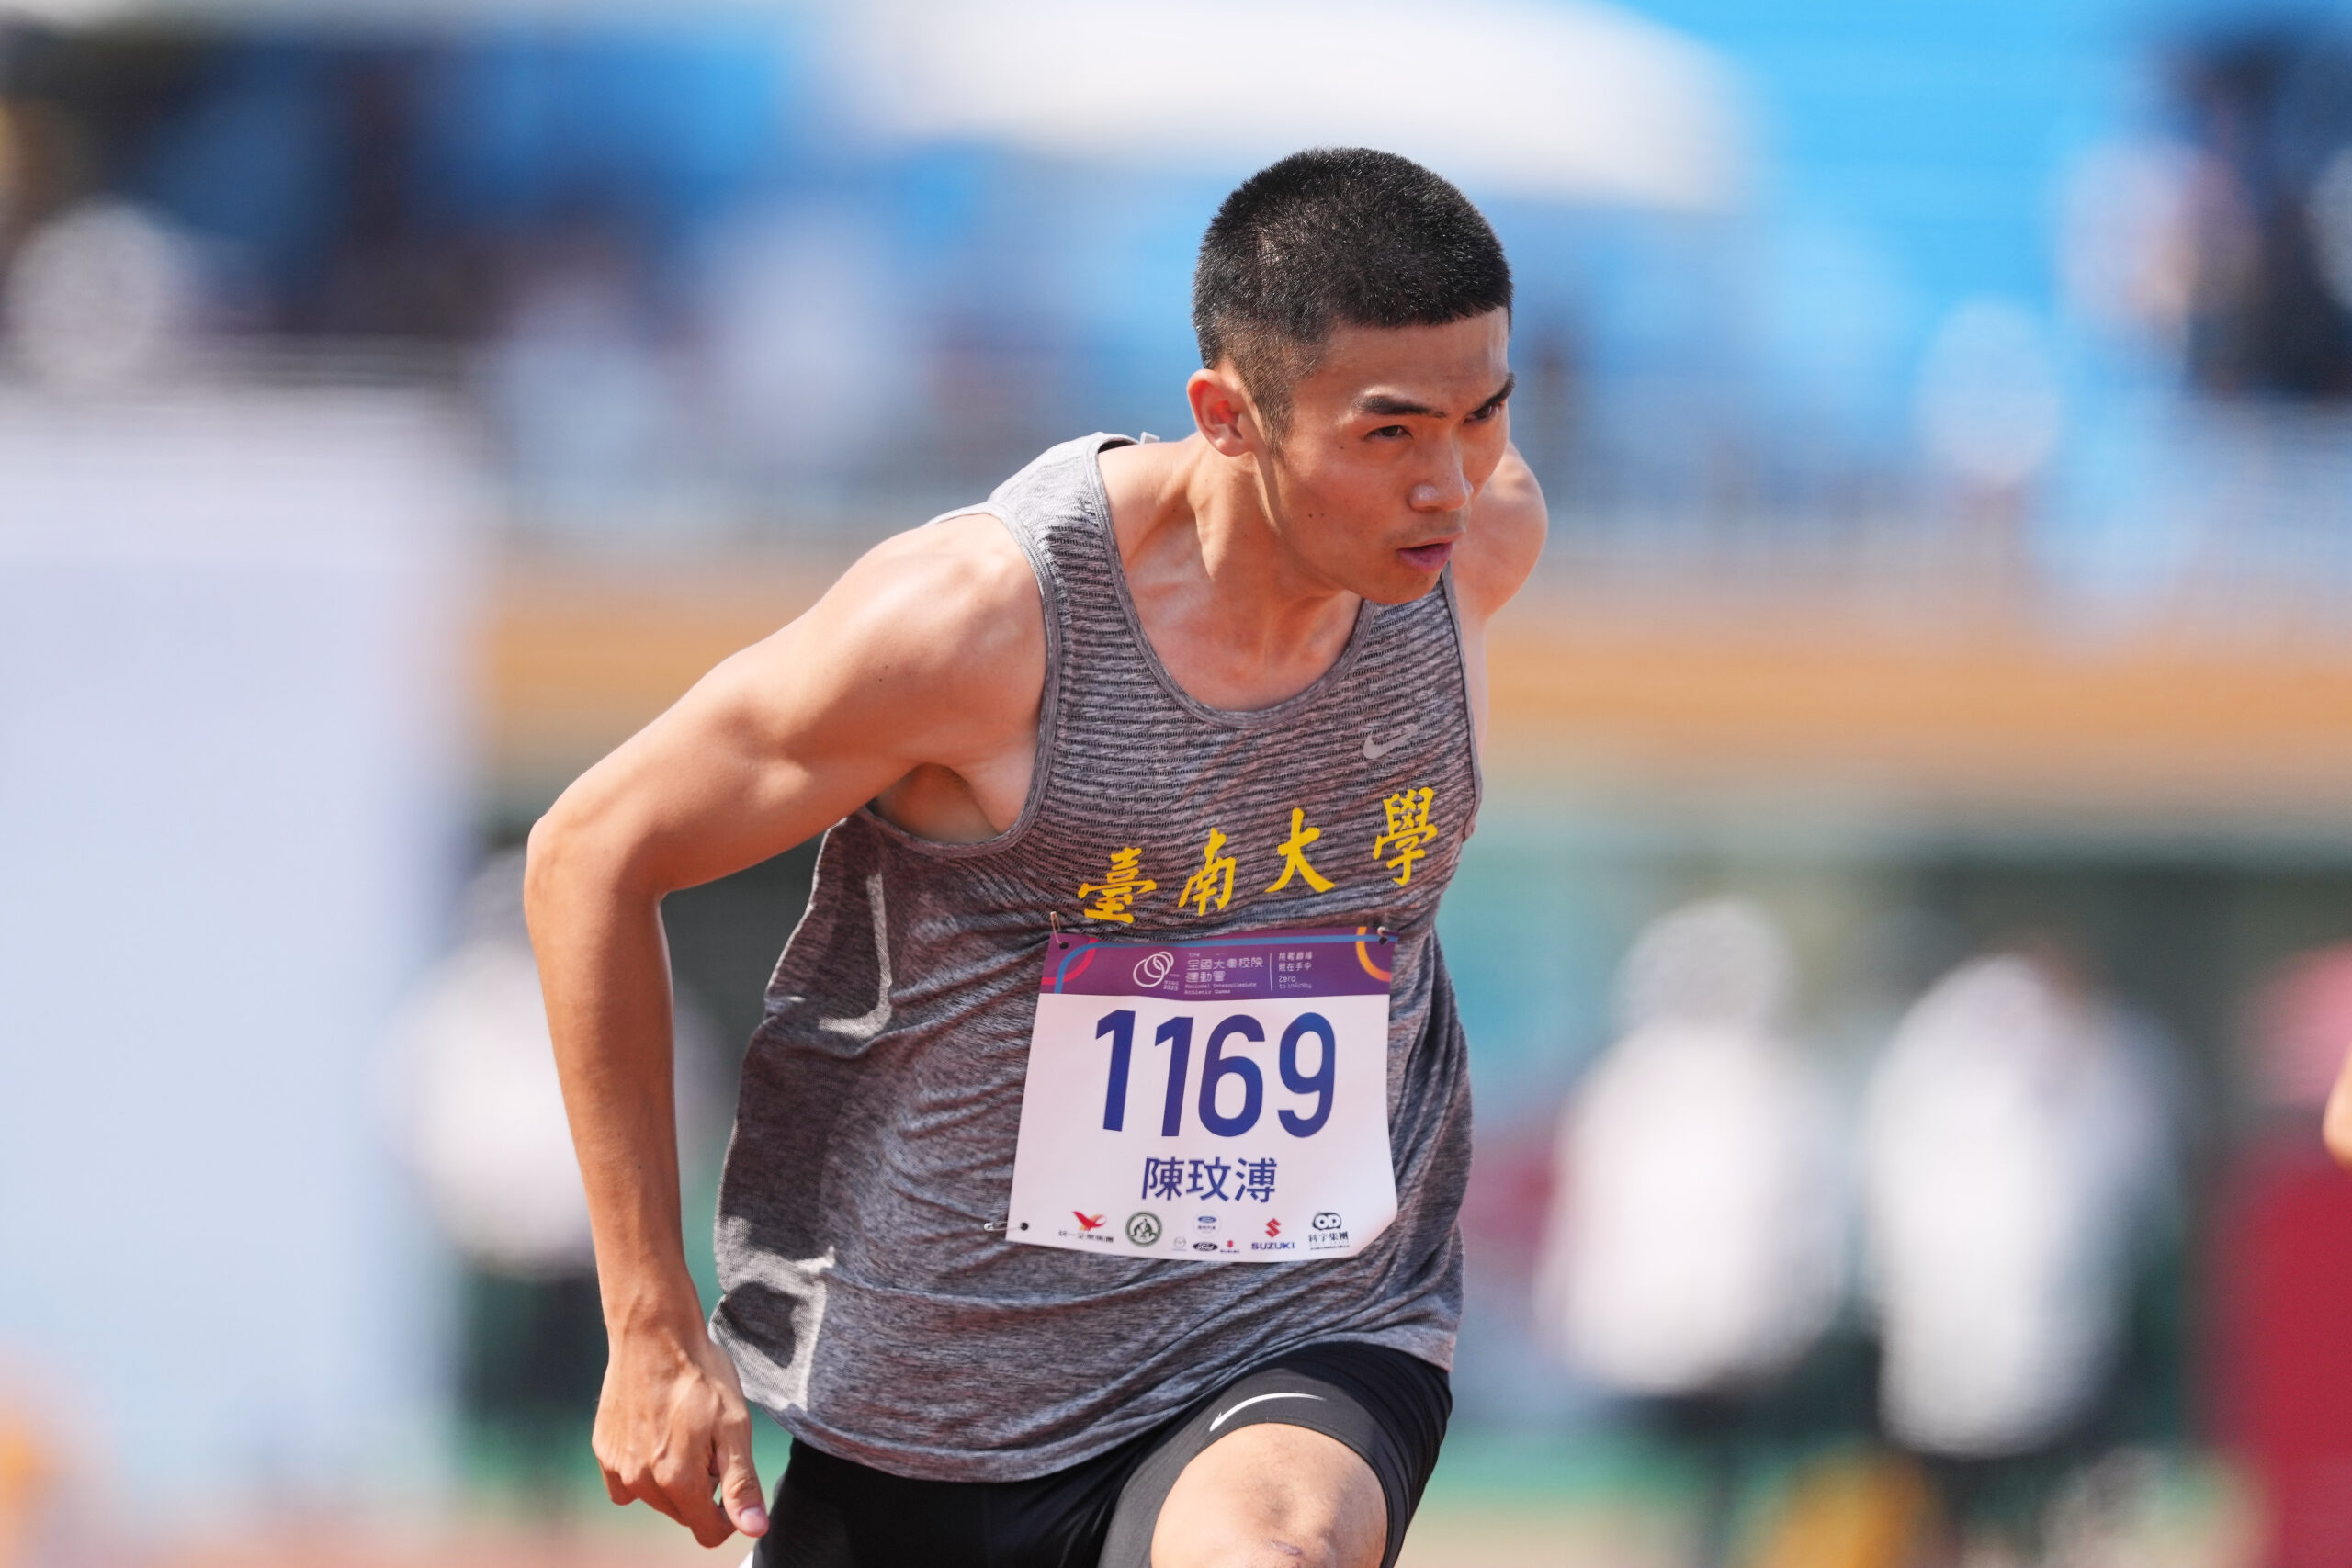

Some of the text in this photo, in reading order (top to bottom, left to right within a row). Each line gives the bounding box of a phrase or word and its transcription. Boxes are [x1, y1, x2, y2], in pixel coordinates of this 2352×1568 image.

[1078, 787, 1438, 923] 臺南大學
[1094, 1010, 1336, 1138] 1169
[1142, 1156, 1278, 1202] 陳玟溥
[1251, 1241, 1295, 1250] SUZUKI
